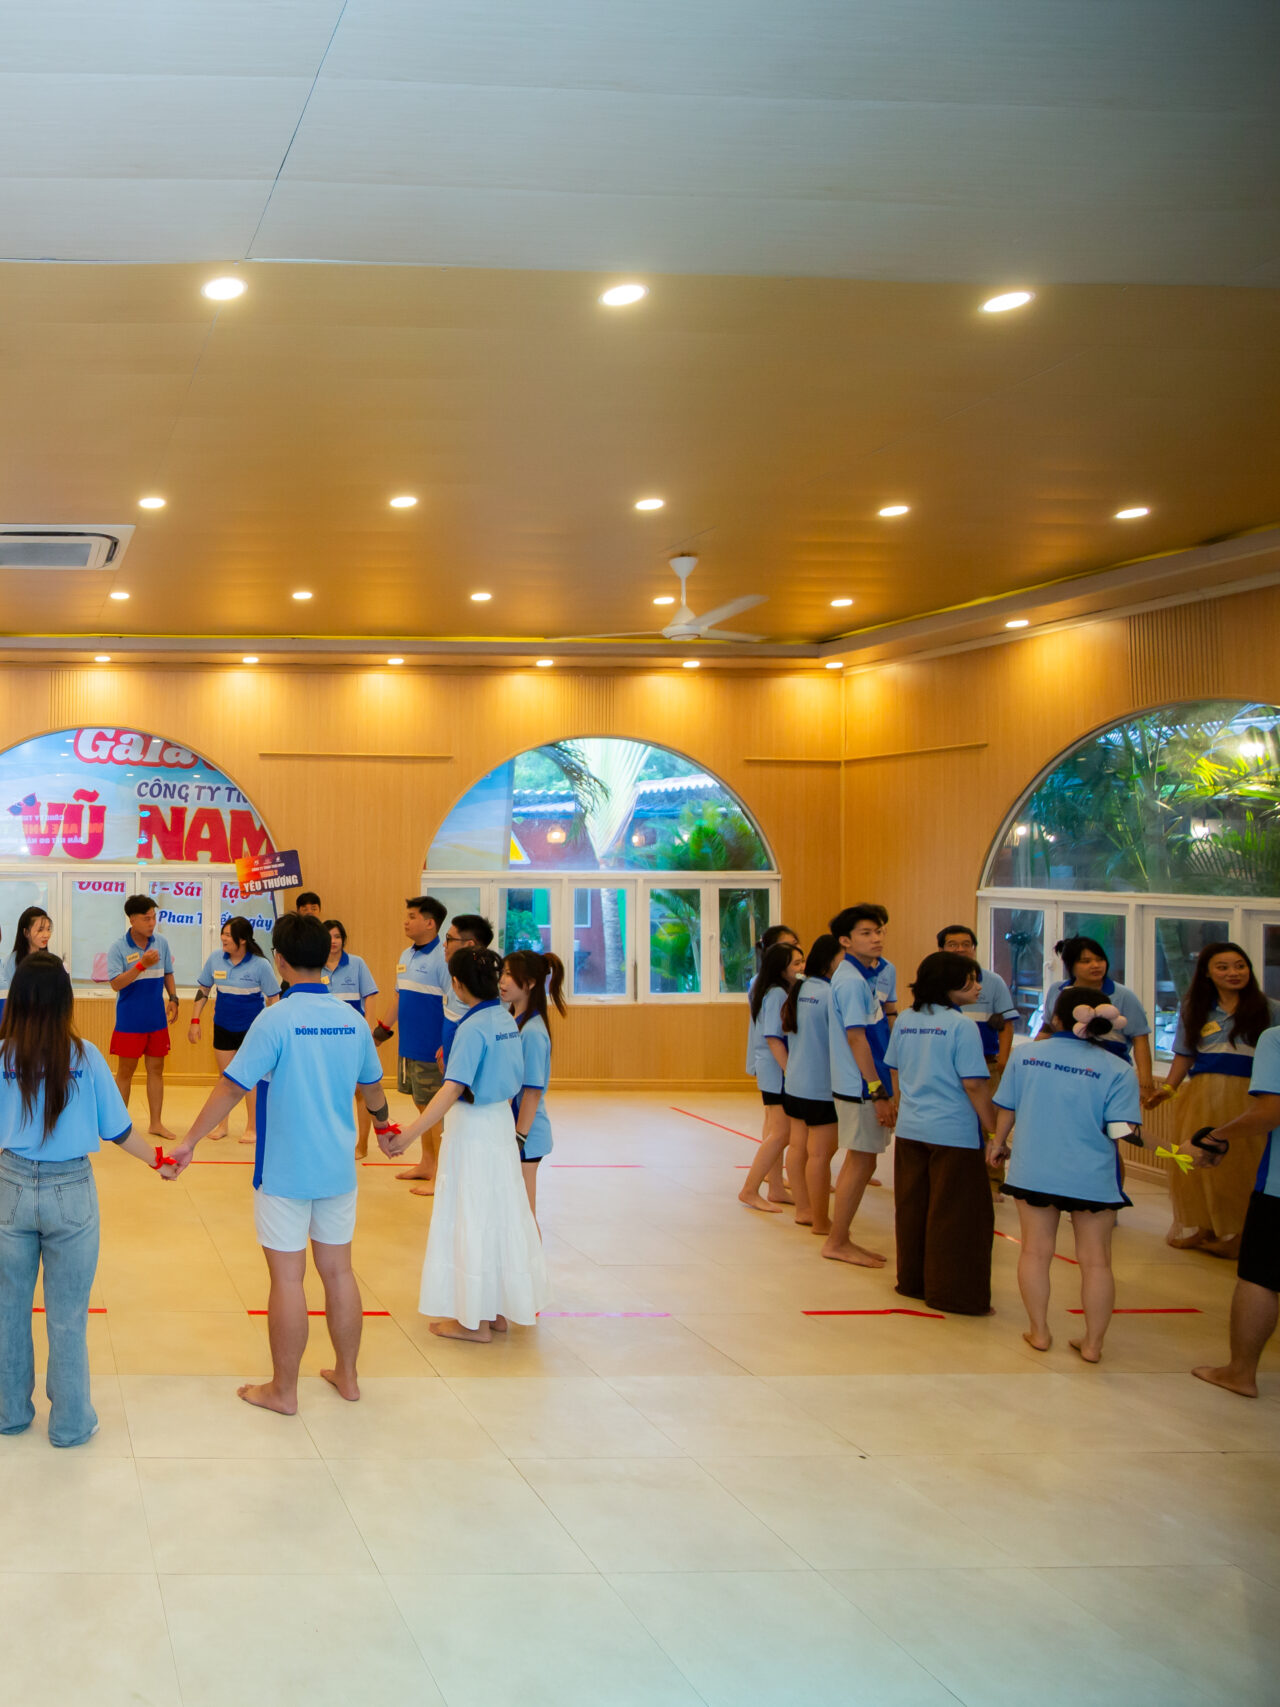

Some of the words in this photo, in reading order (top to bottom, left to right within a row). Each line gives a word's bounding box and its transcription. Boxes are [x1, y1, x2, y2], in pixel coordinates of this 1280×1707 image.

[137, 779, 189, 803] CÔNG
[195, 785, 220, 801] TY
[21, 788, 107, 859] VŨ
[136, 804, 275, 863] NAM
[244, 880, 261, 892] YÊU
[158, 911, 193, 923] Phan
[320, 1024, 355, 1035] NGUYÊN
[1054, 1063, 1101, 1079] NGUYÊN
